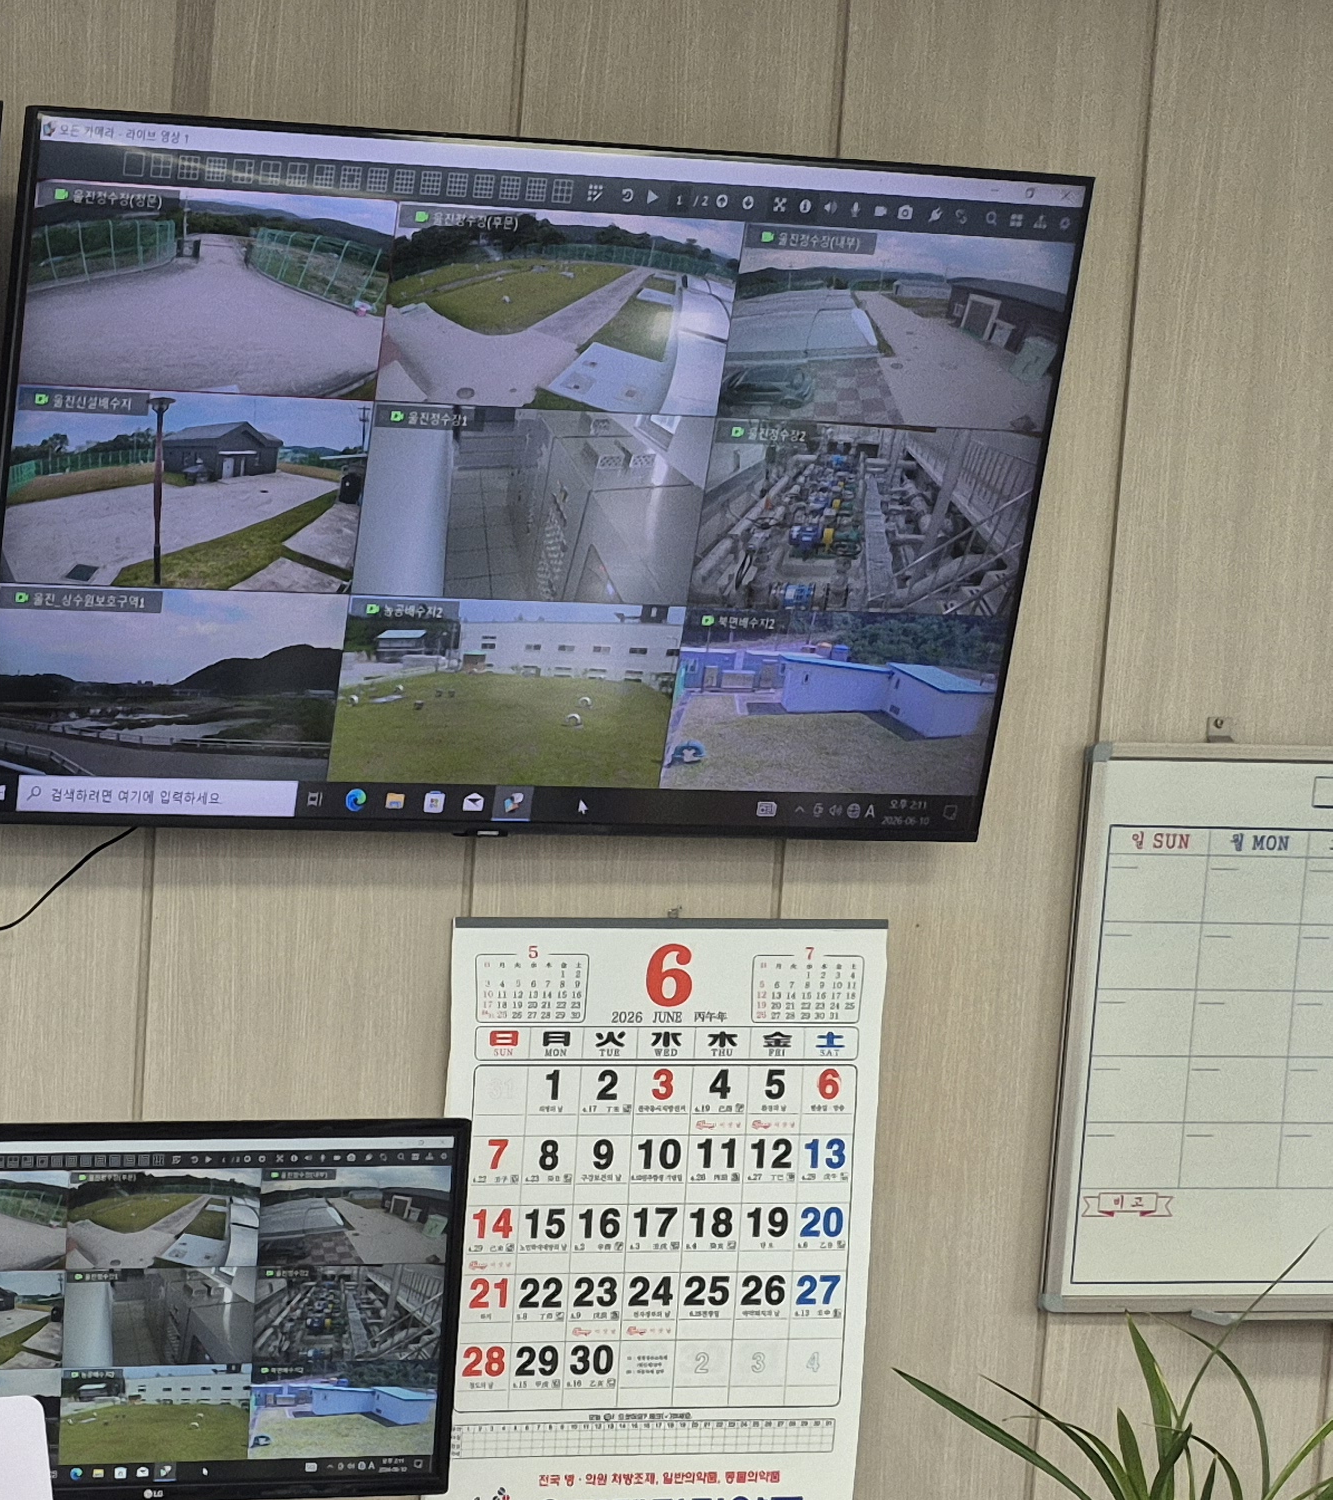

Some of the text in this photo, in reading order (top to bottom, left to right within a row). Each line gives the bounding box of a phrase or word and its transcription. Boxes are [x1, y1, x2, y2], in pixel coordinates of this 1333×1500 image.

[83, 126, 114, 139] 카메라
[125, 127, 156, 141] 라이브
[161, 130, 180, 144] 영상
[51, 787, 223, 807] 검색하려면 여기에 입력하세요
[864, 804, 875, 818] A
[1153, 834, 1190, 850] SUN
[1252, 834, 1290, 851] MON
[528, 945, 539, 960] 5
[804, 946, 815, 960] 7
[645, 943, 693, 1008] 6
[611, 1011, 729, 1024] 2026 JUNE 丙午年
[489, 1031, 519, 1047] 日
[493, 1049, 514, 1057] SUN
[541, 1031, 572, 1048] 月
[544, 1048, 568, 1057] MON
[595, 1031, 627, 1048] 火
[599, 1048, 621, 1057] TUE
[651, 1031, 683, 1048] 水
[654, 1048, 678, 1057] WED
[706, 1031, 739, 1048] 木
[711, 1048, 733, 1057] THU
[762, 1031, 793, 1048] 金
[768, 1048, 787, 1057] FRI
[814, 1031, 846, 1049] 土
[819, 1048, 840, 1057] SAT
[545, 1069, 560, 1100] 1
[596, 1069, 619, 1100] 2
[651, 1068, 674, 1100] 3
[709, 1069, 731, 1100] 4
[764, 1069, 786, 1100] 5
[818, 1068, 841, 1100] 6
[488, 1139, 509, 1169] 7
[539, 1139, 559, 1170] 8
[593, 1139, 614, 1170] 9
[637, 1138, 681, 1170] 10
[697, 1138, 736, 1169] 11
[750, 1138, 793, 1169] 12
[804, 1138, 846, 1169] 13
[472, 1208, 513, 1239] 14
[525, 1208, 565, 1239] 15
[579, 1207, 621, 1239] 16
[633, 1207, 678, 1238] 17
[689, 1207, 733, 1238] 18
[747, 1207, 789, 1238] 19
[800, 1207, 844, 1238] 20
[469, 1277, 508, 1309] 21
[518, 1277, 563, 1308] 22
[573, 1276, 618, 1307] 23
[628, 1275, 673, 1307] 24
[683, 1275, 730, 1306] 25
[740, 1275, 786, 1306] 26
[795, 1275, 842, 1306] 27
[461, 1346, 505, 1377] 28
[514, 1345, 559, 1377] 29
[569, 1344, 614, 1376] 30
[694, 1351, 710, 1374] 2
[751, 1351, 766, 1373] 3
[806, 1351, 820, 1373] 4
[538, 1474, 561, 1487] 전국
[585, 1472, 608, 1486] 의원
[611, 1472, 659, 1487] 처방조제,
